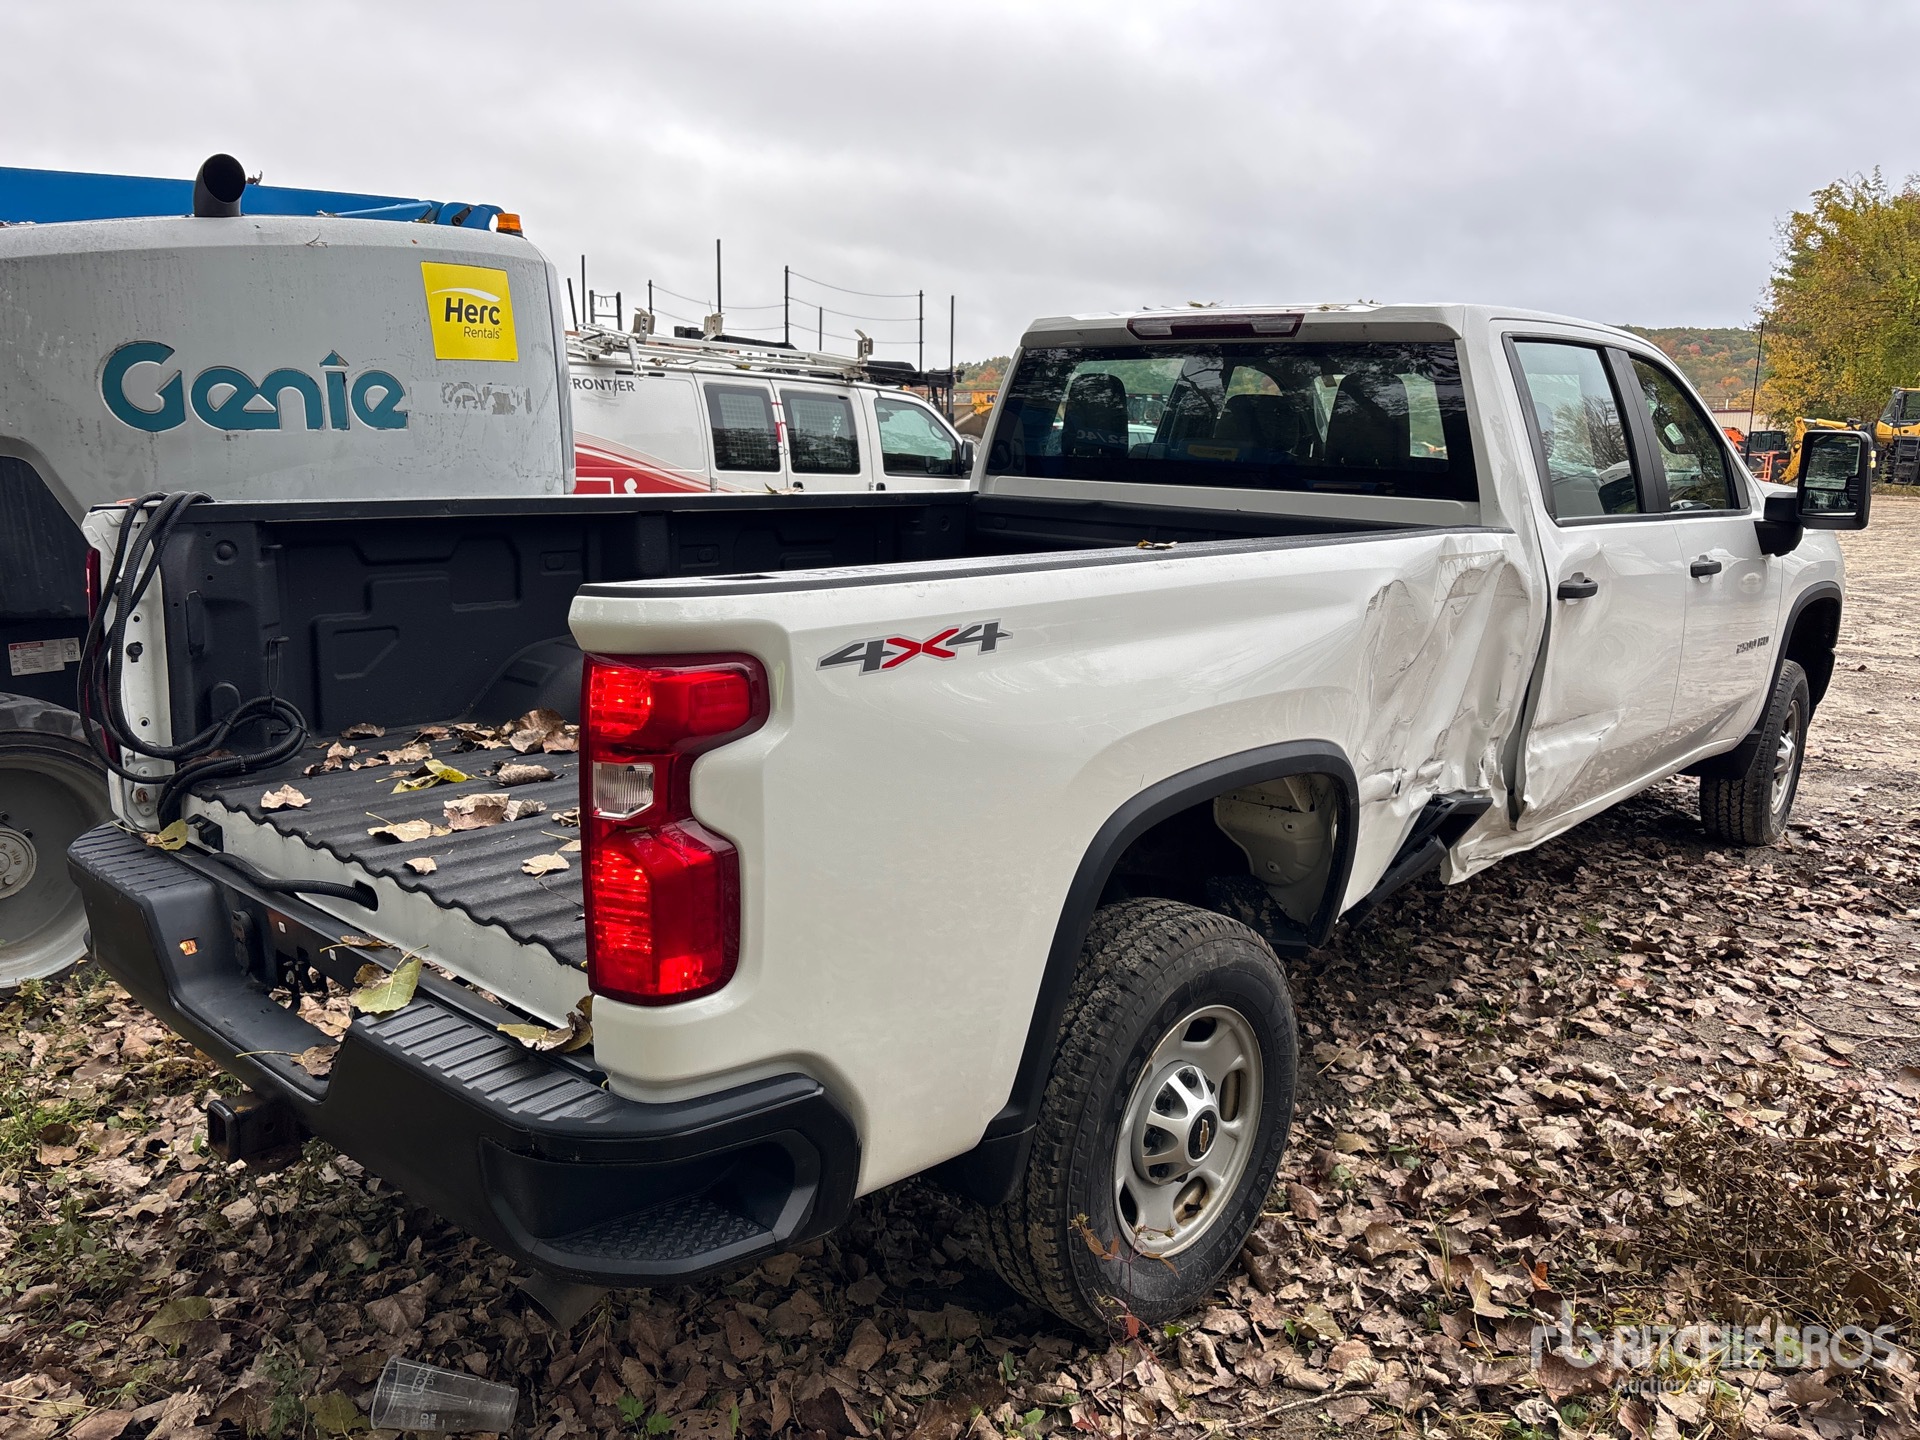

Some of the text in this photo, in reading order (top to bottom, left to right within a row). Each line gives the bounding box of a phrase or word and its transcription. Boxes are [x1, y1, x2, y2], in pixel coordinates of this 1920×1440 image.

[444, 297, 501, 325] Herc
[463, 326, 500, 339] Rentals
[101, 340, 409, 432] Genie
